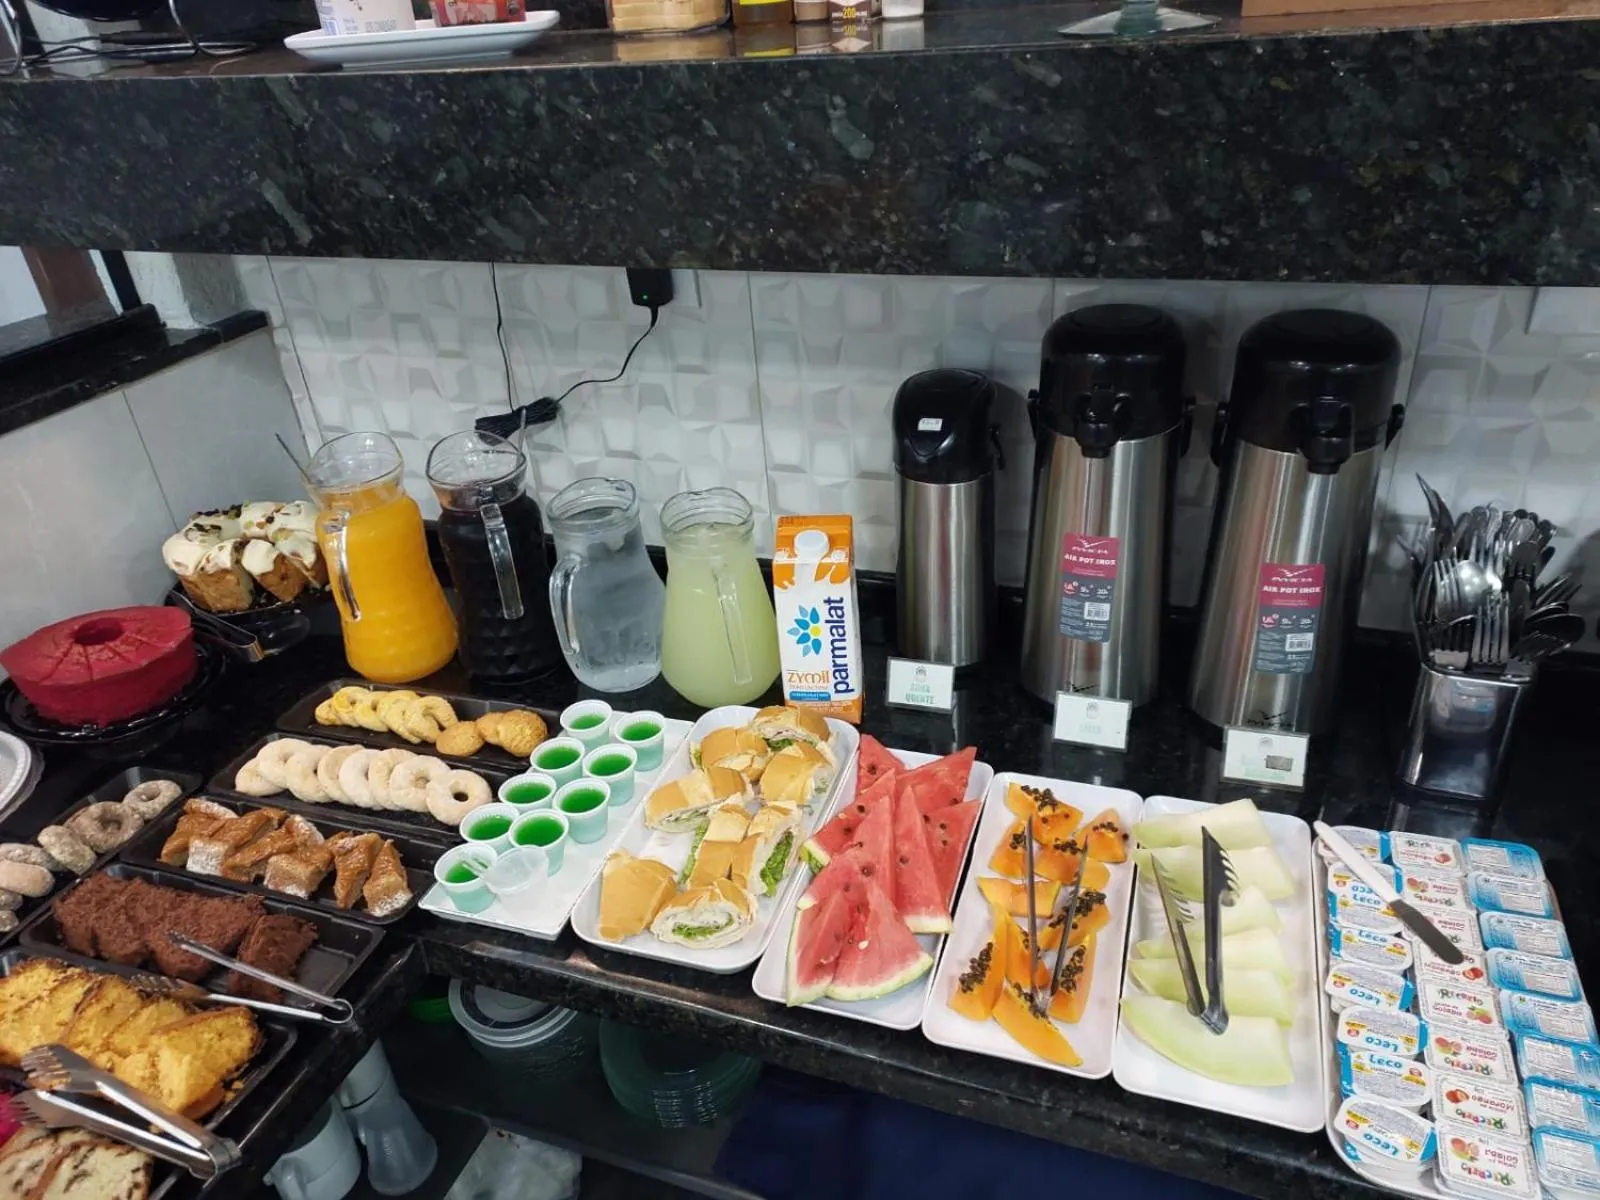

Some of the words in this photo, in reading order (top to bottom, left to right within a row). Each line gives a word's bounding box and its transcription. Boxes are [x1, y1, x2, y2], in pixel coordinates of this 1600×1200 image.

[824, 596, 855, 695] parmalat
[1351, 884, 1375, 894] eco
[1352, 893, 1381, 906] Leco
[1357, 930, 1388, 943] Leco
[1349, 987, 1380, 1005] Leco
[1365, 1035, 1399, 1053] Leco
[1369, 1054, 1403, 1070] Leco
[1363, 1132, 1400, 1156] Leco
